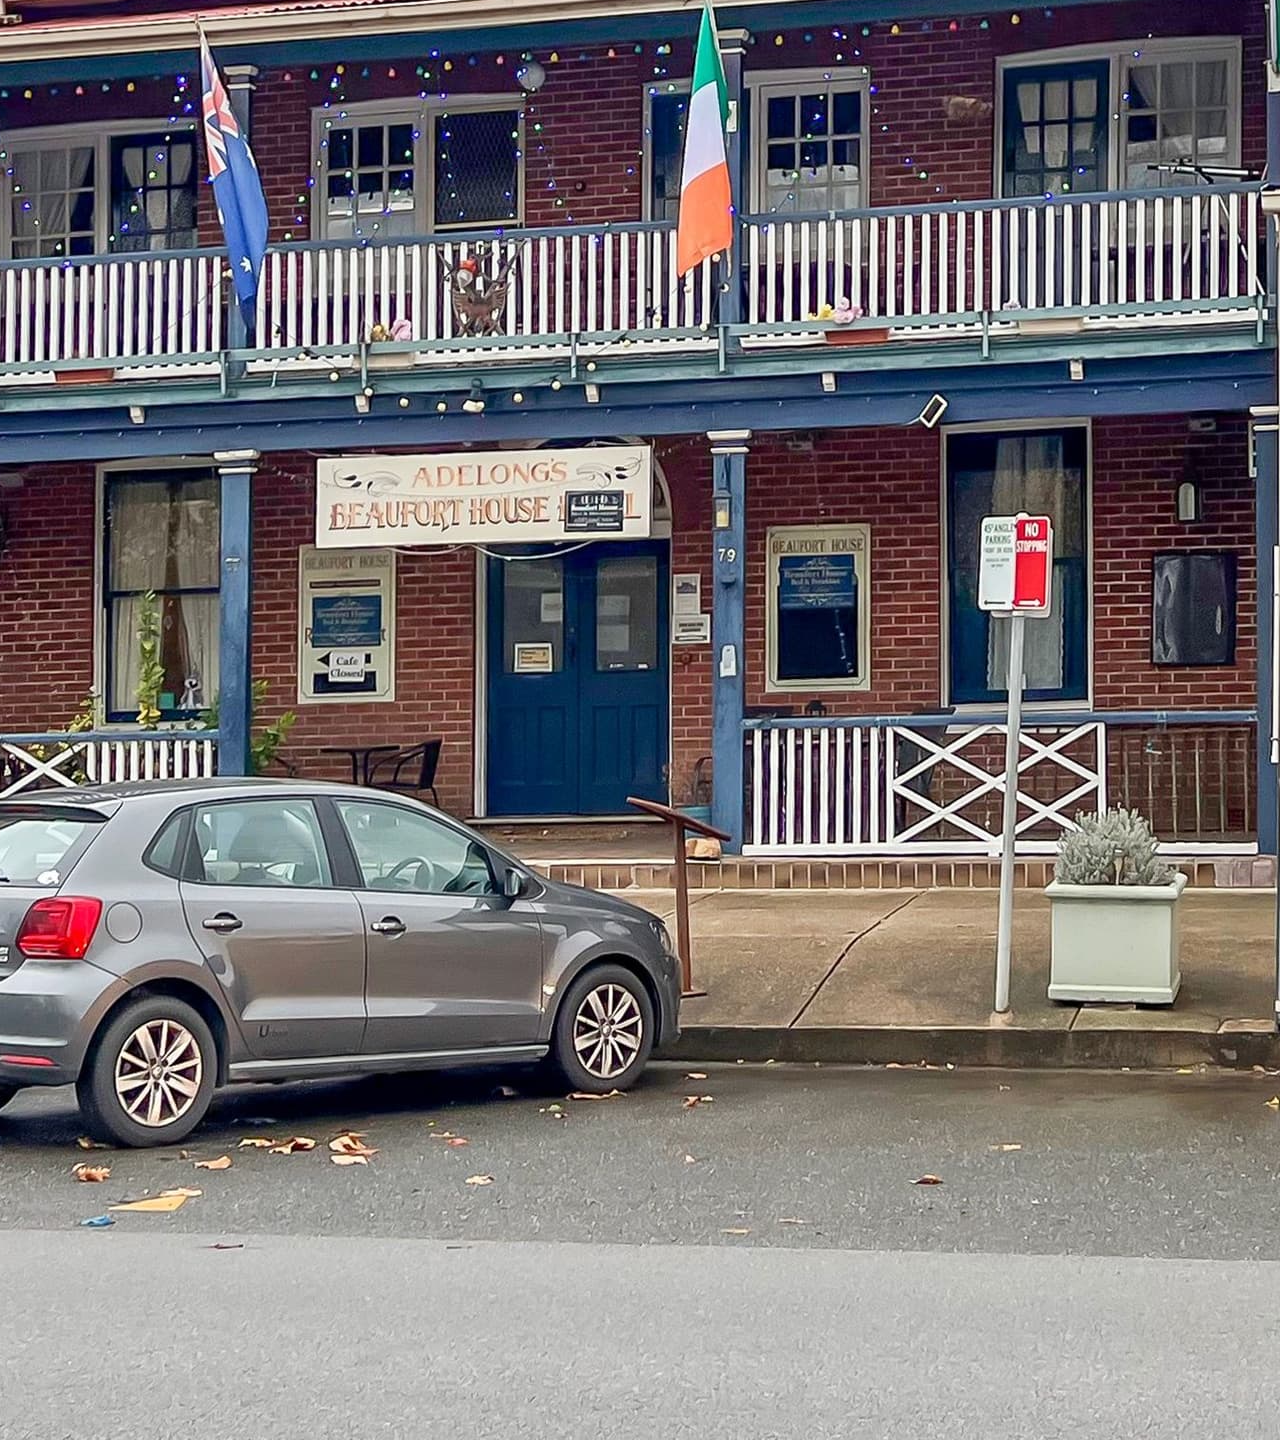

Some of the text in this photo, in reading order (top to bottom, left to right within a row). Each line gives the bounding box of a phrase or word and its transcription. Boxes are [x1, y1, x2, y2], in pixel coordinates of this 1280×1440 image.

[412, 458, 568, 488] ADELONG'S
[328, 497, 464, 532] BEAUFORT
[469, 494, 551, 525] HOUSE
[1025, 522, 1039, 537] NO
[772, 537, 864, 554] BEAUFORT HOUSE
[985, 535, 1011, 545] PARKING
[1016, 540, 1047, 553] STOPPING
[718, 548, 736, 562] 79
[336, 656, 359, 666] Cafe
[330, 668, 364, 678] Closed
